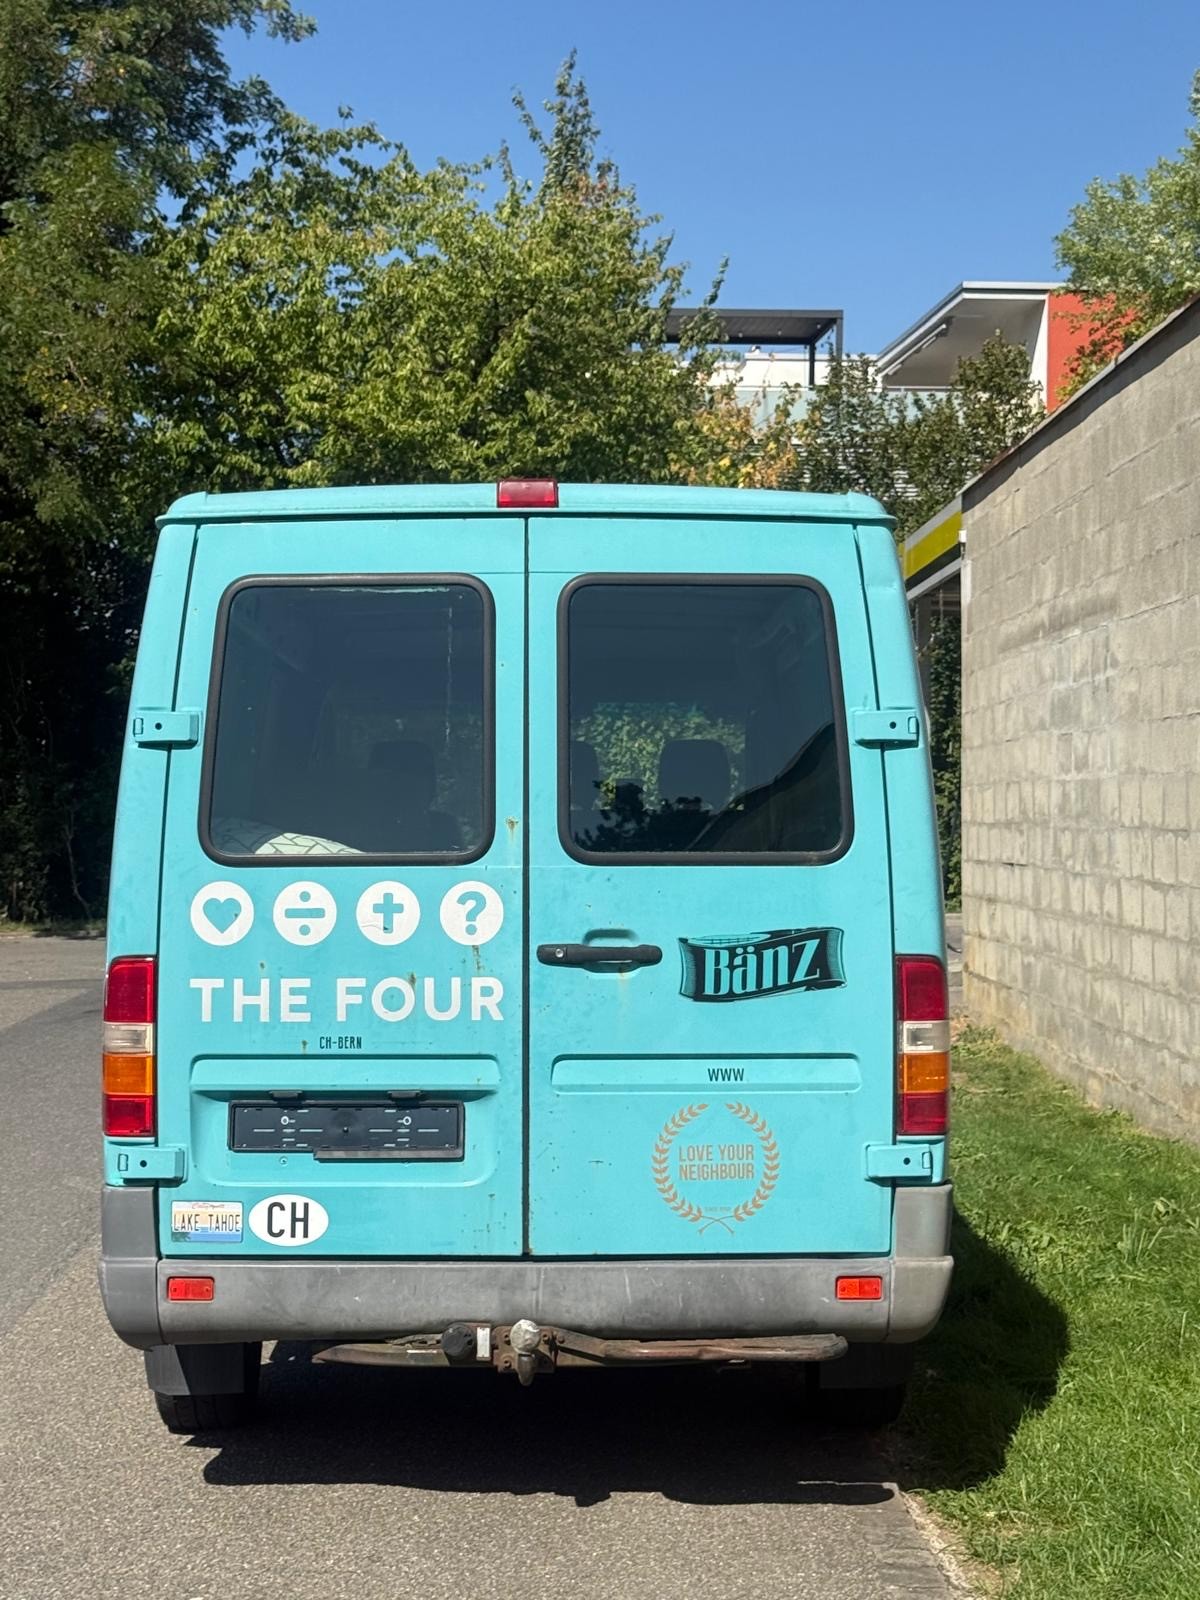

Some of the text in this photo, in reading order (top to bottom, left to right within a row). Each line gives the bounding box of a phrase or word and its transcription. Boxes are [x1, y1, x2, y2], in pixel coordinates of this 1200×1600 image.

[189, 976, 505, 1022] THE FOUR
[319, 1036, 362, 1049] CH-BERN
[679, 1144, 754, 1162] LOVE YOUR
[679, 1163, 755, 1181] NEIGHBOUR
[173, 1213, 241, 1232] LAKE TAHOE
[267, 1201, 310, 1239] CH
